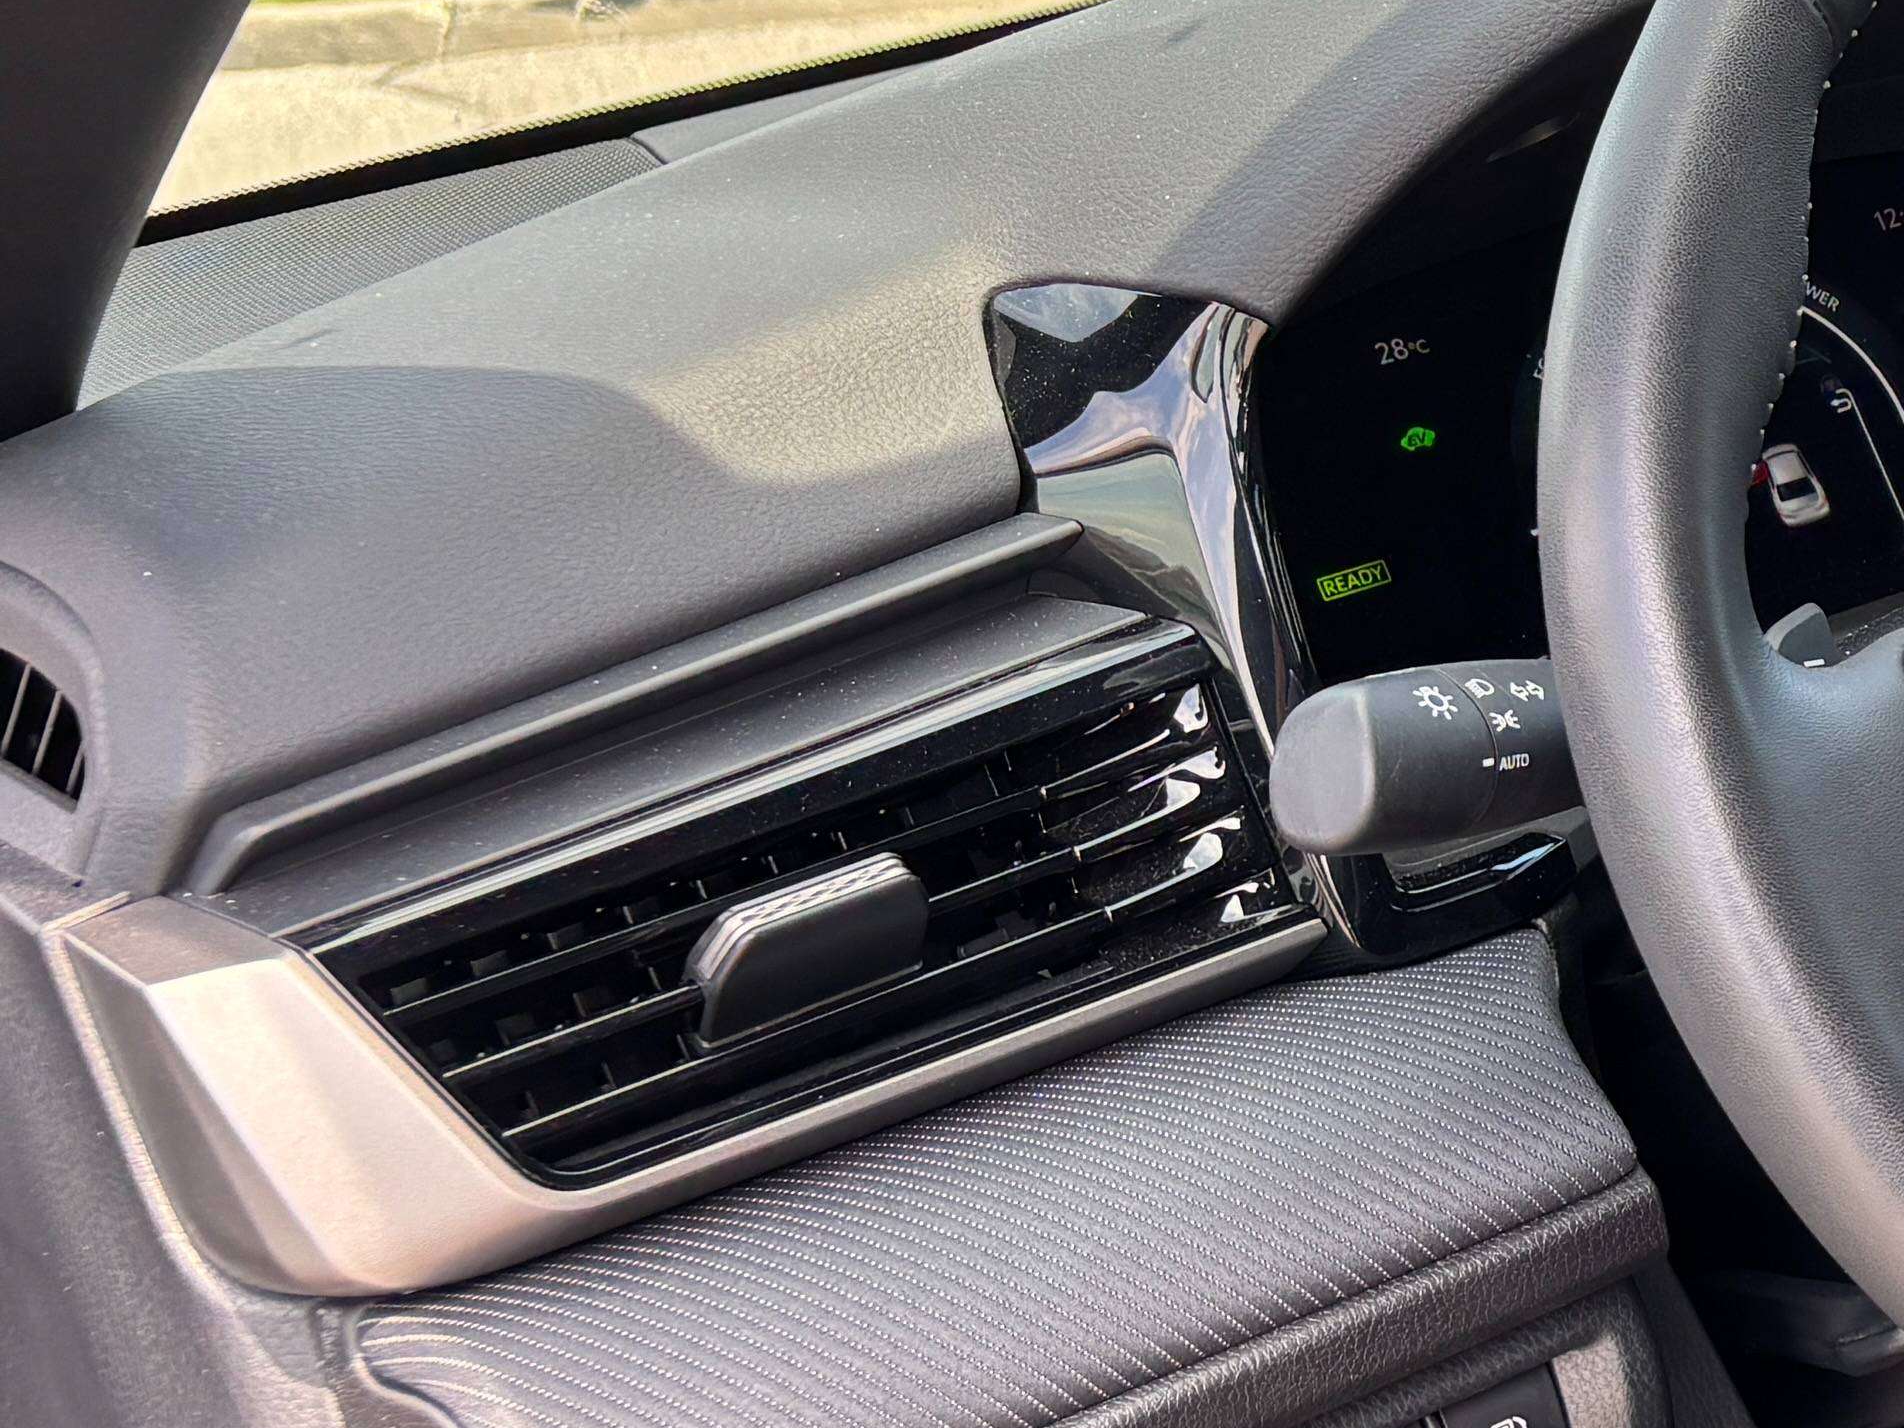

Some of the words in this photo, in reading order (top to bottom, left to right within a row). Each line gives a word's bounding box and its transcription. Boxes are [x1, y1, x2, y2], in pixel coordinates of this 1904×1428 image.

[1805, 280, 1841, 313] WER
[1322, 566, 1384, 597] READY
[1498, 752, 1531, 772] AUTO
